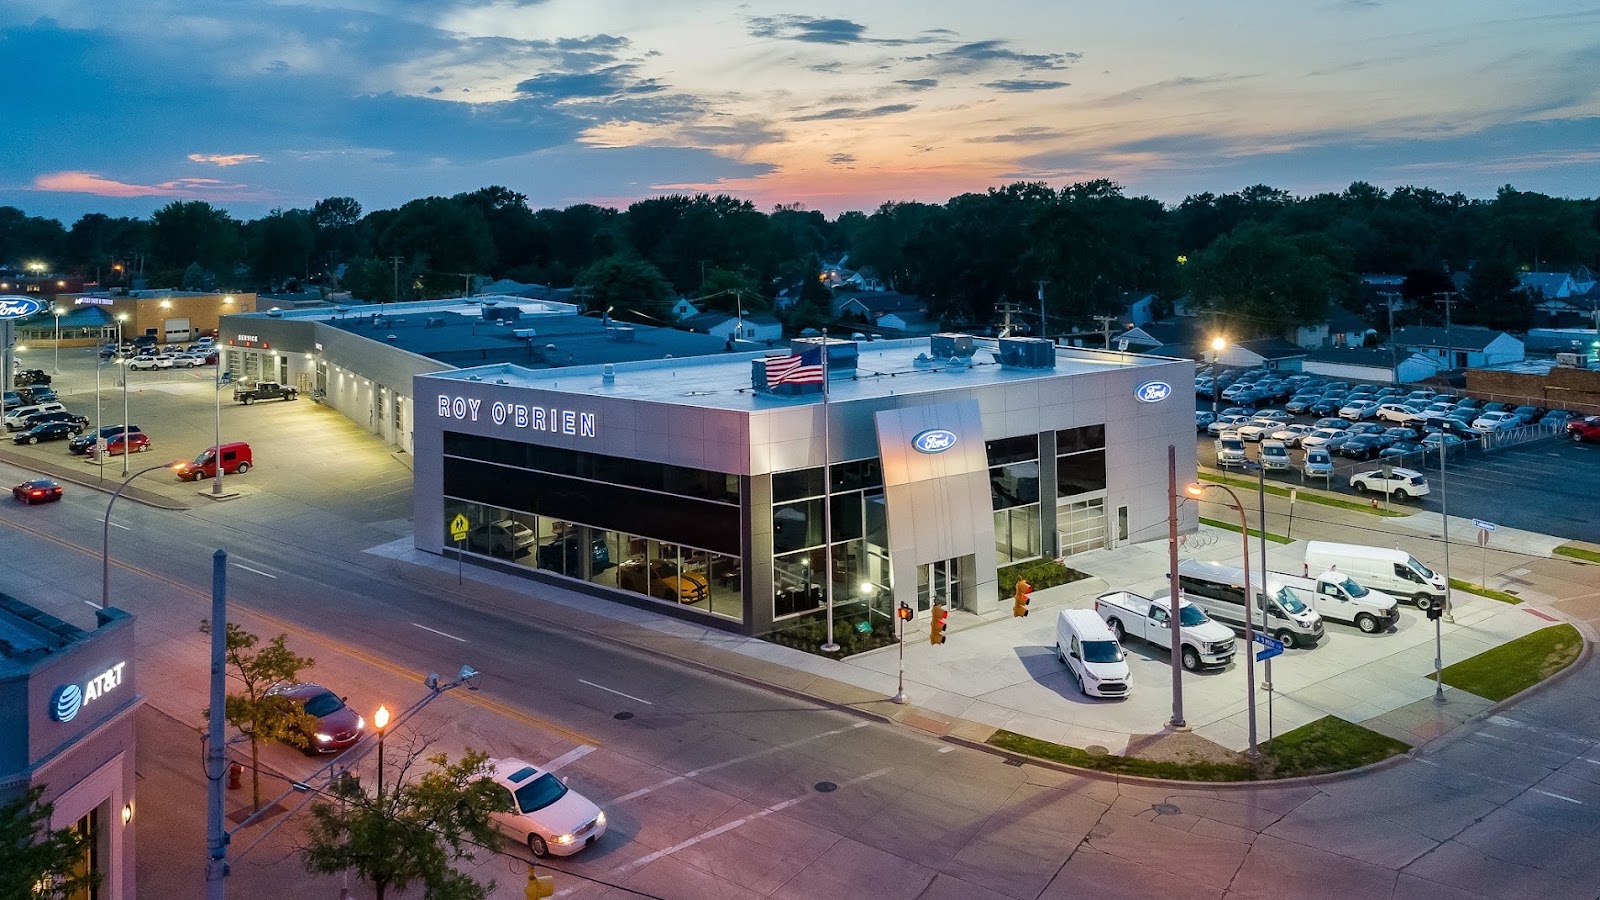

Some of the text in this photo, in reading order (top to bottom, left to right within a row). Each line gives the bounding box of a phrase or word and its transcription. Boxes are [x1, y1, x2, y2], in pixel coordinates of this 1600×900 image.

[1144, 385, 1166, 400] Ford
[438, 394, 595, 438] ROY O'BRIEN
[925, 434, 949, 450] Ford
[83, 661, 125, 706] AT&T
